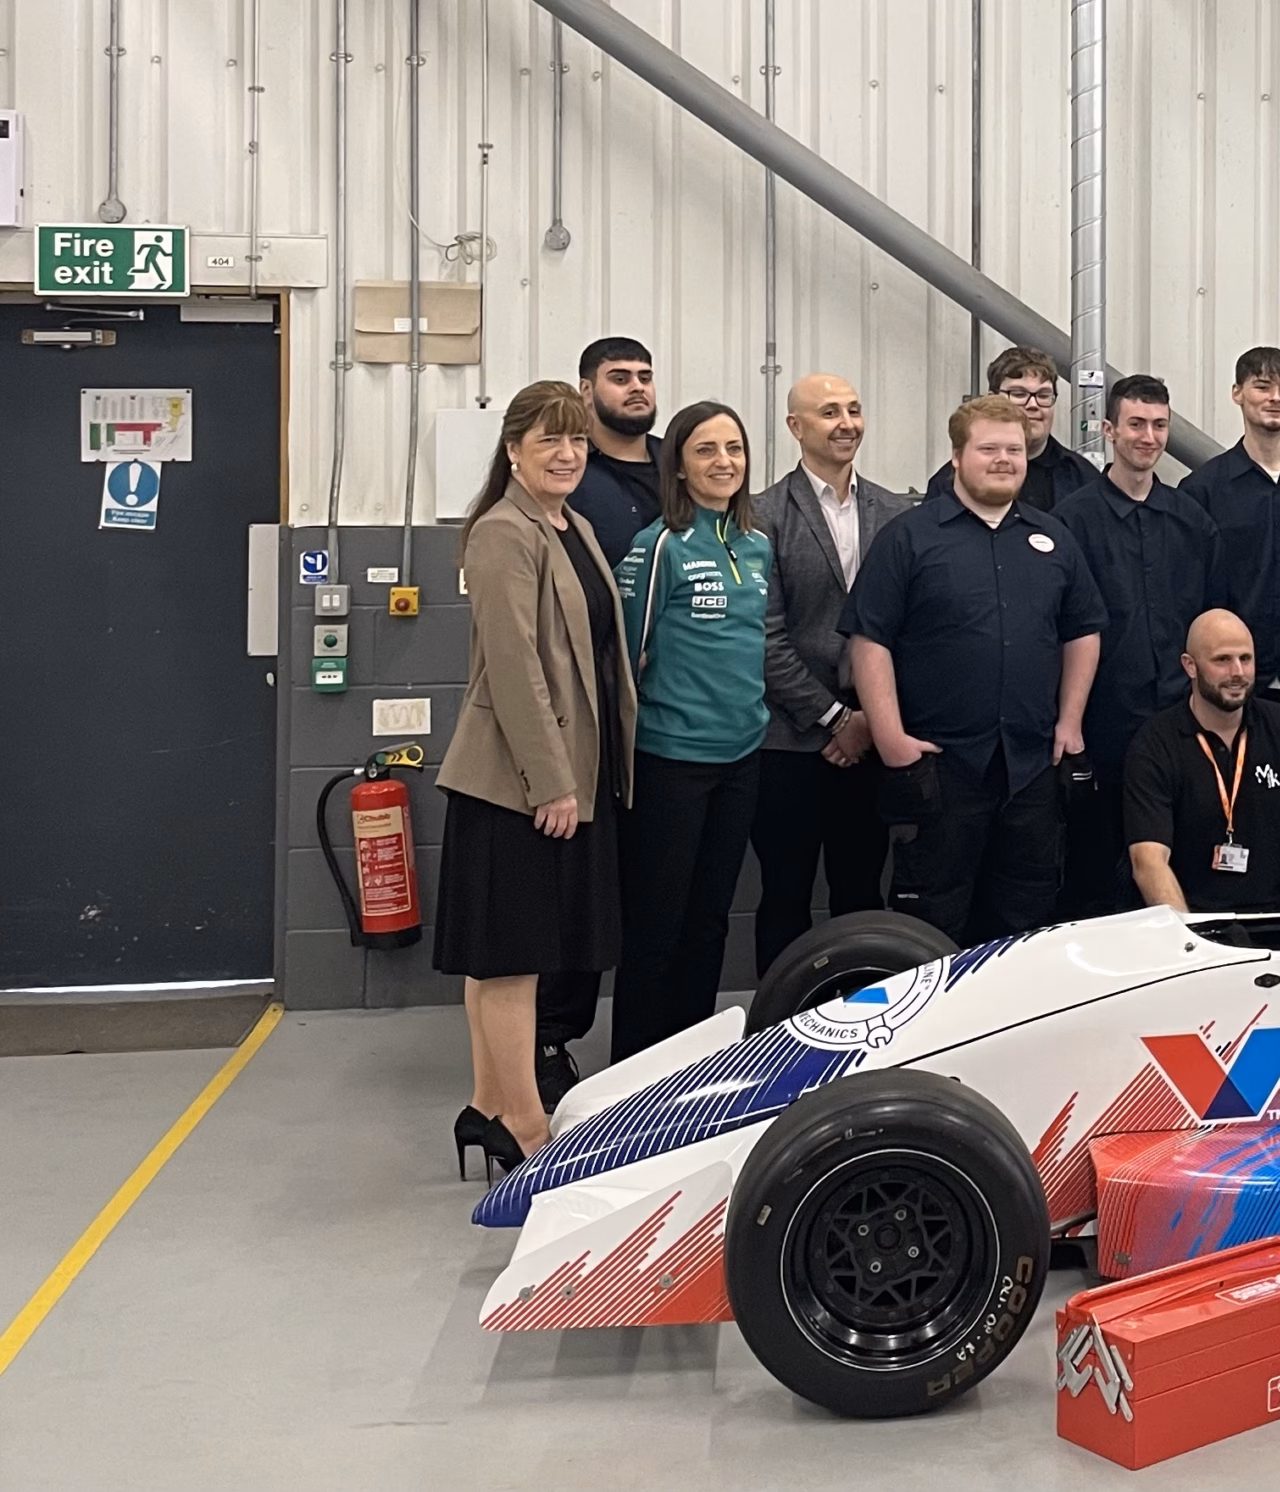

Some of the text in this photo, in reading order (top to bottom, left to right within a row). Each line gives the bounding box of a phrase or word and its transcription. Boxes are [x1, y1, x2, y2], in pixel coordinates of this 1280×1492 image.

[54, 232, 115, 257] Fire
[211, 257, 229, 266] 404
[54, 261, 114, 285] exit
[694, 581, 725, 592] BOSS
[694, 597, 726, 607] JCB
